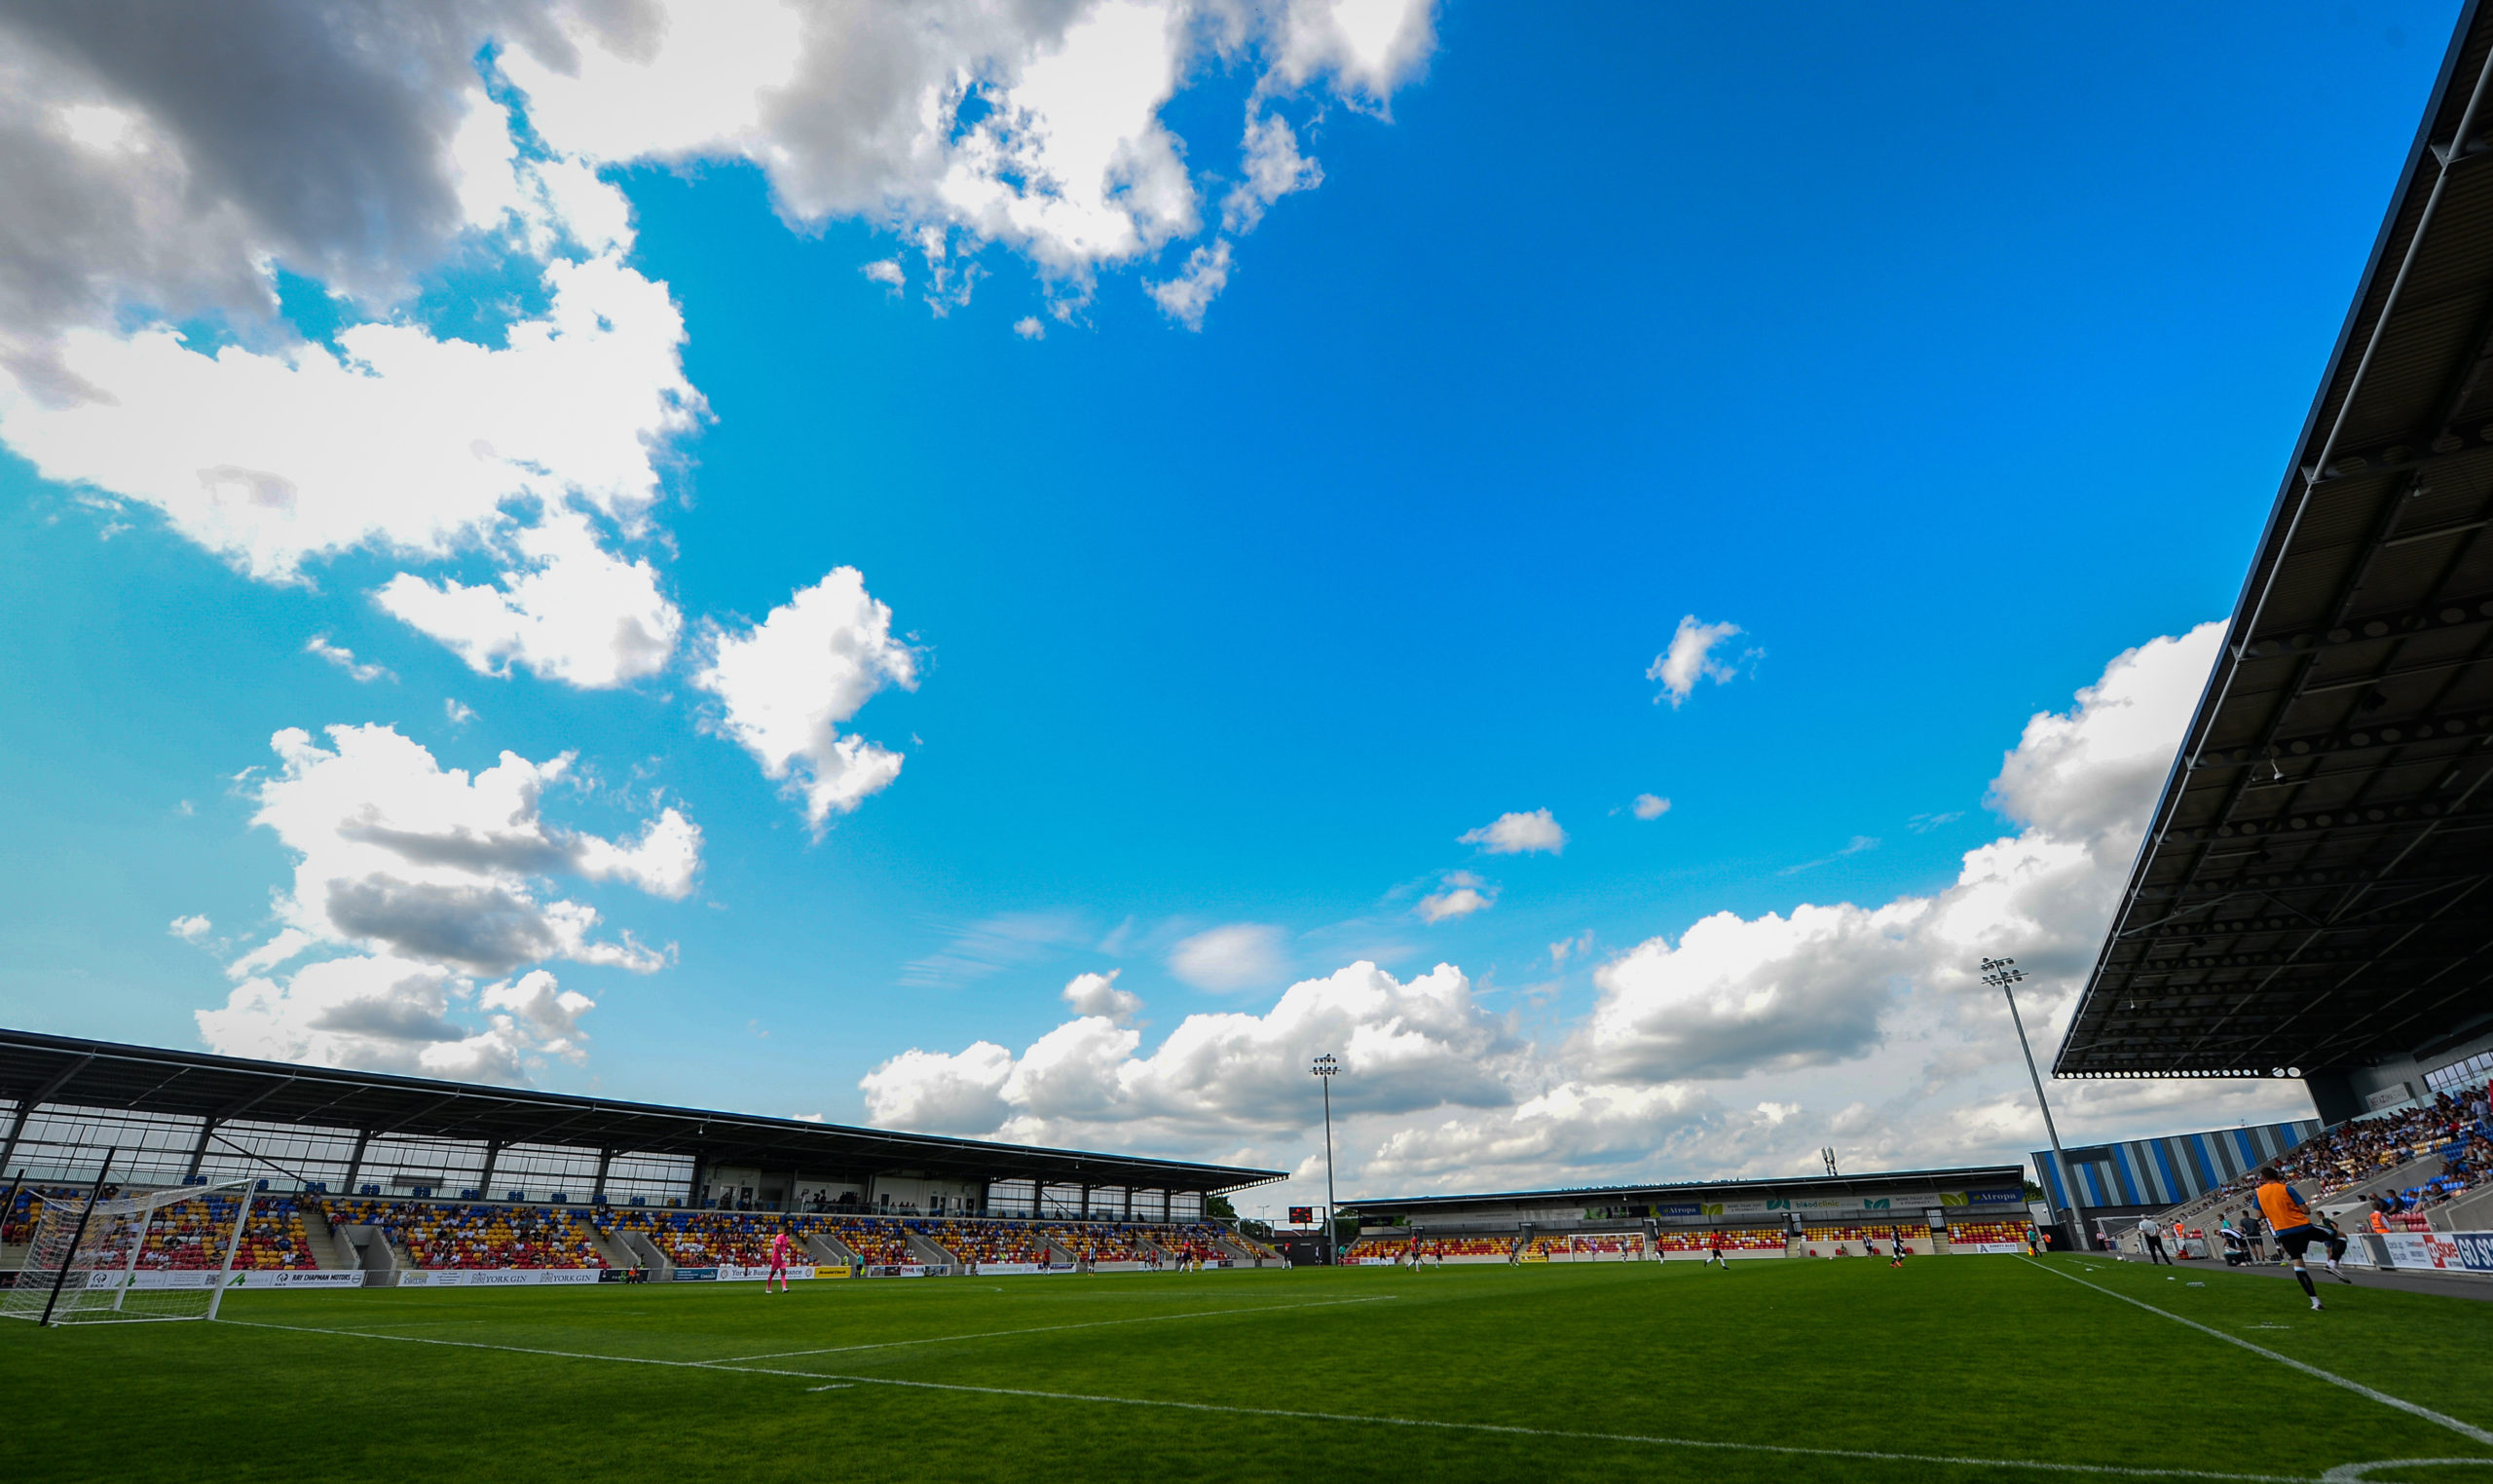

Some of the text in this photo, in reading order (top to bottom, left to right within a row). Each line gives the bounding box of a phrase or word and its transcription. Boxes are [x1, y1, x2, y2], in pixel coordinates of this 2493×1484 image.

[1981, 1192, 2017, 1201] Atropa
[2457, 1239, 2480, 1266] GO
[2475, 1239, 2493, 1266] SC
